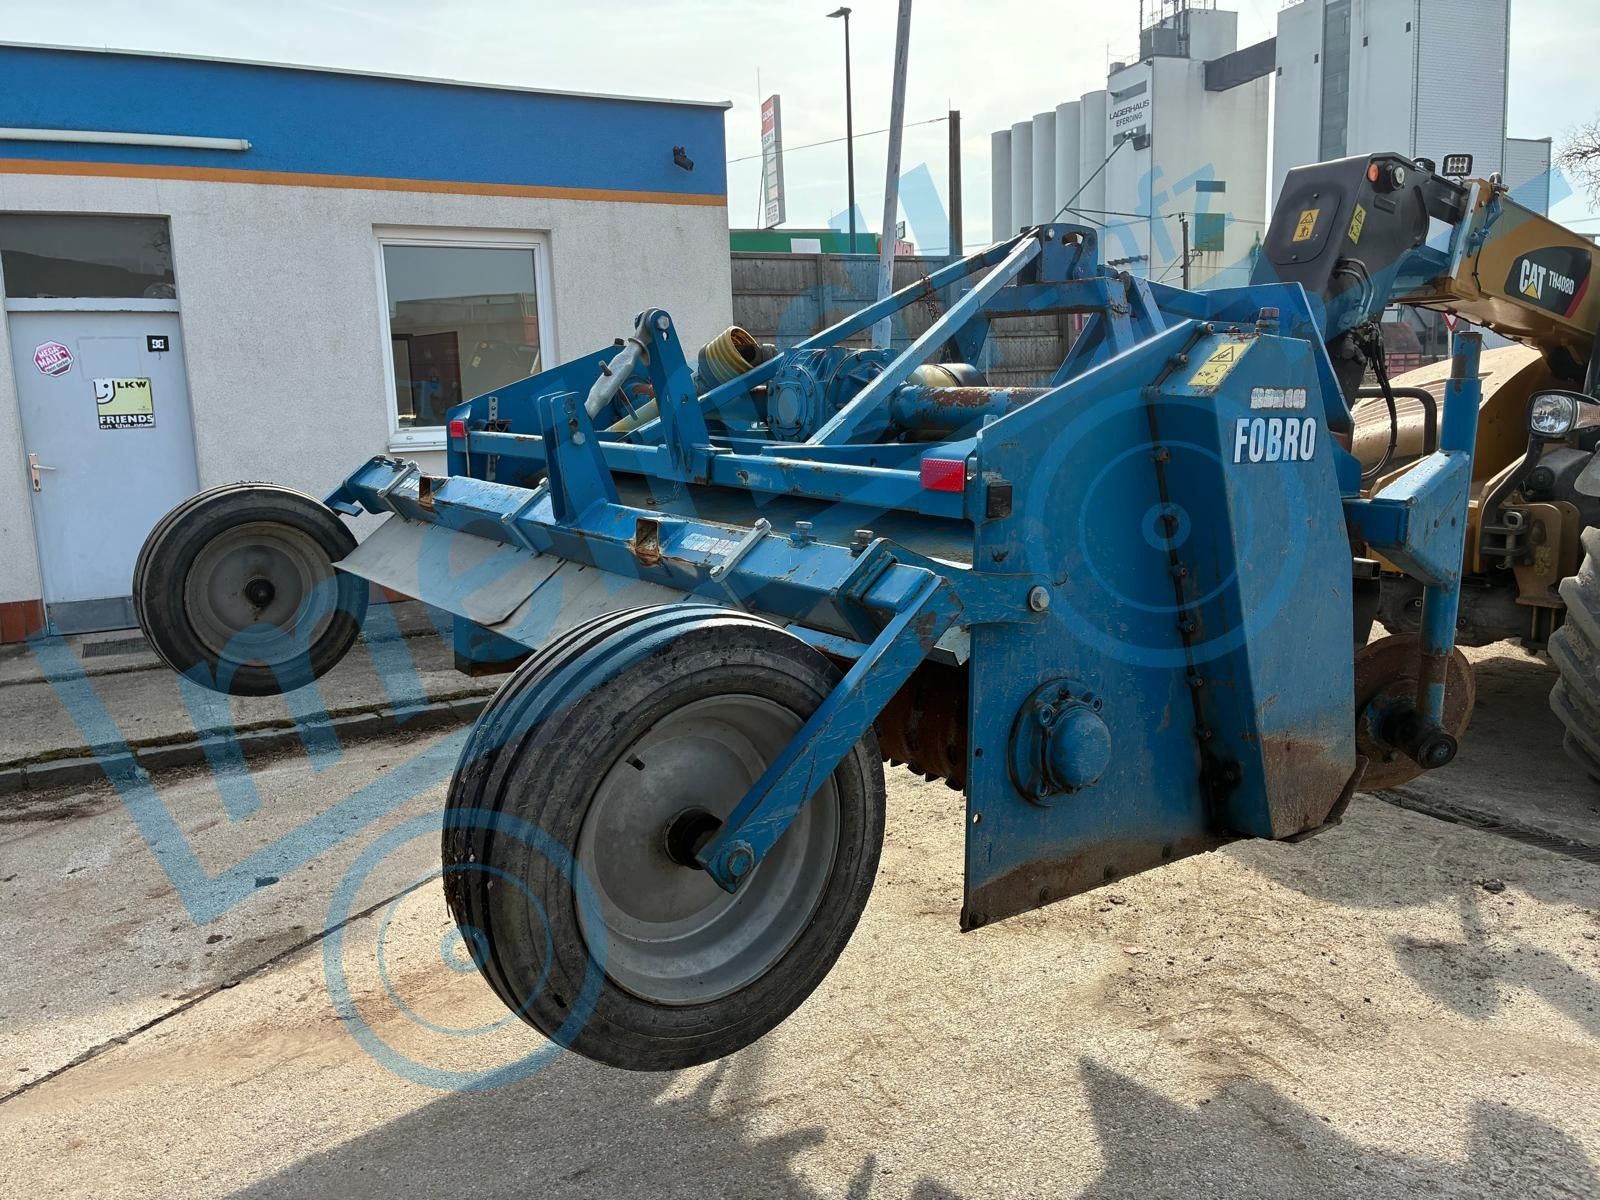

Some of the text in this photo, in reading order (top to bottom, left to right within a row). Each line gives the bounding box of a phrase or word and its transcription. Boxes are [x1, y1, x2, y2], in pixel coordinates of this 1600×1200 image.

[1109, 100, 1150, 120] LAGERHAUS
[1115, 112, 1143, 127] EFERDING
[1519, 259, 1547, 300] CAT
[117, 381, 147, 389] LKW
[100, 414, 154, 424] FRIENDS
[1234, 418, 1317, 463] FOBRO
